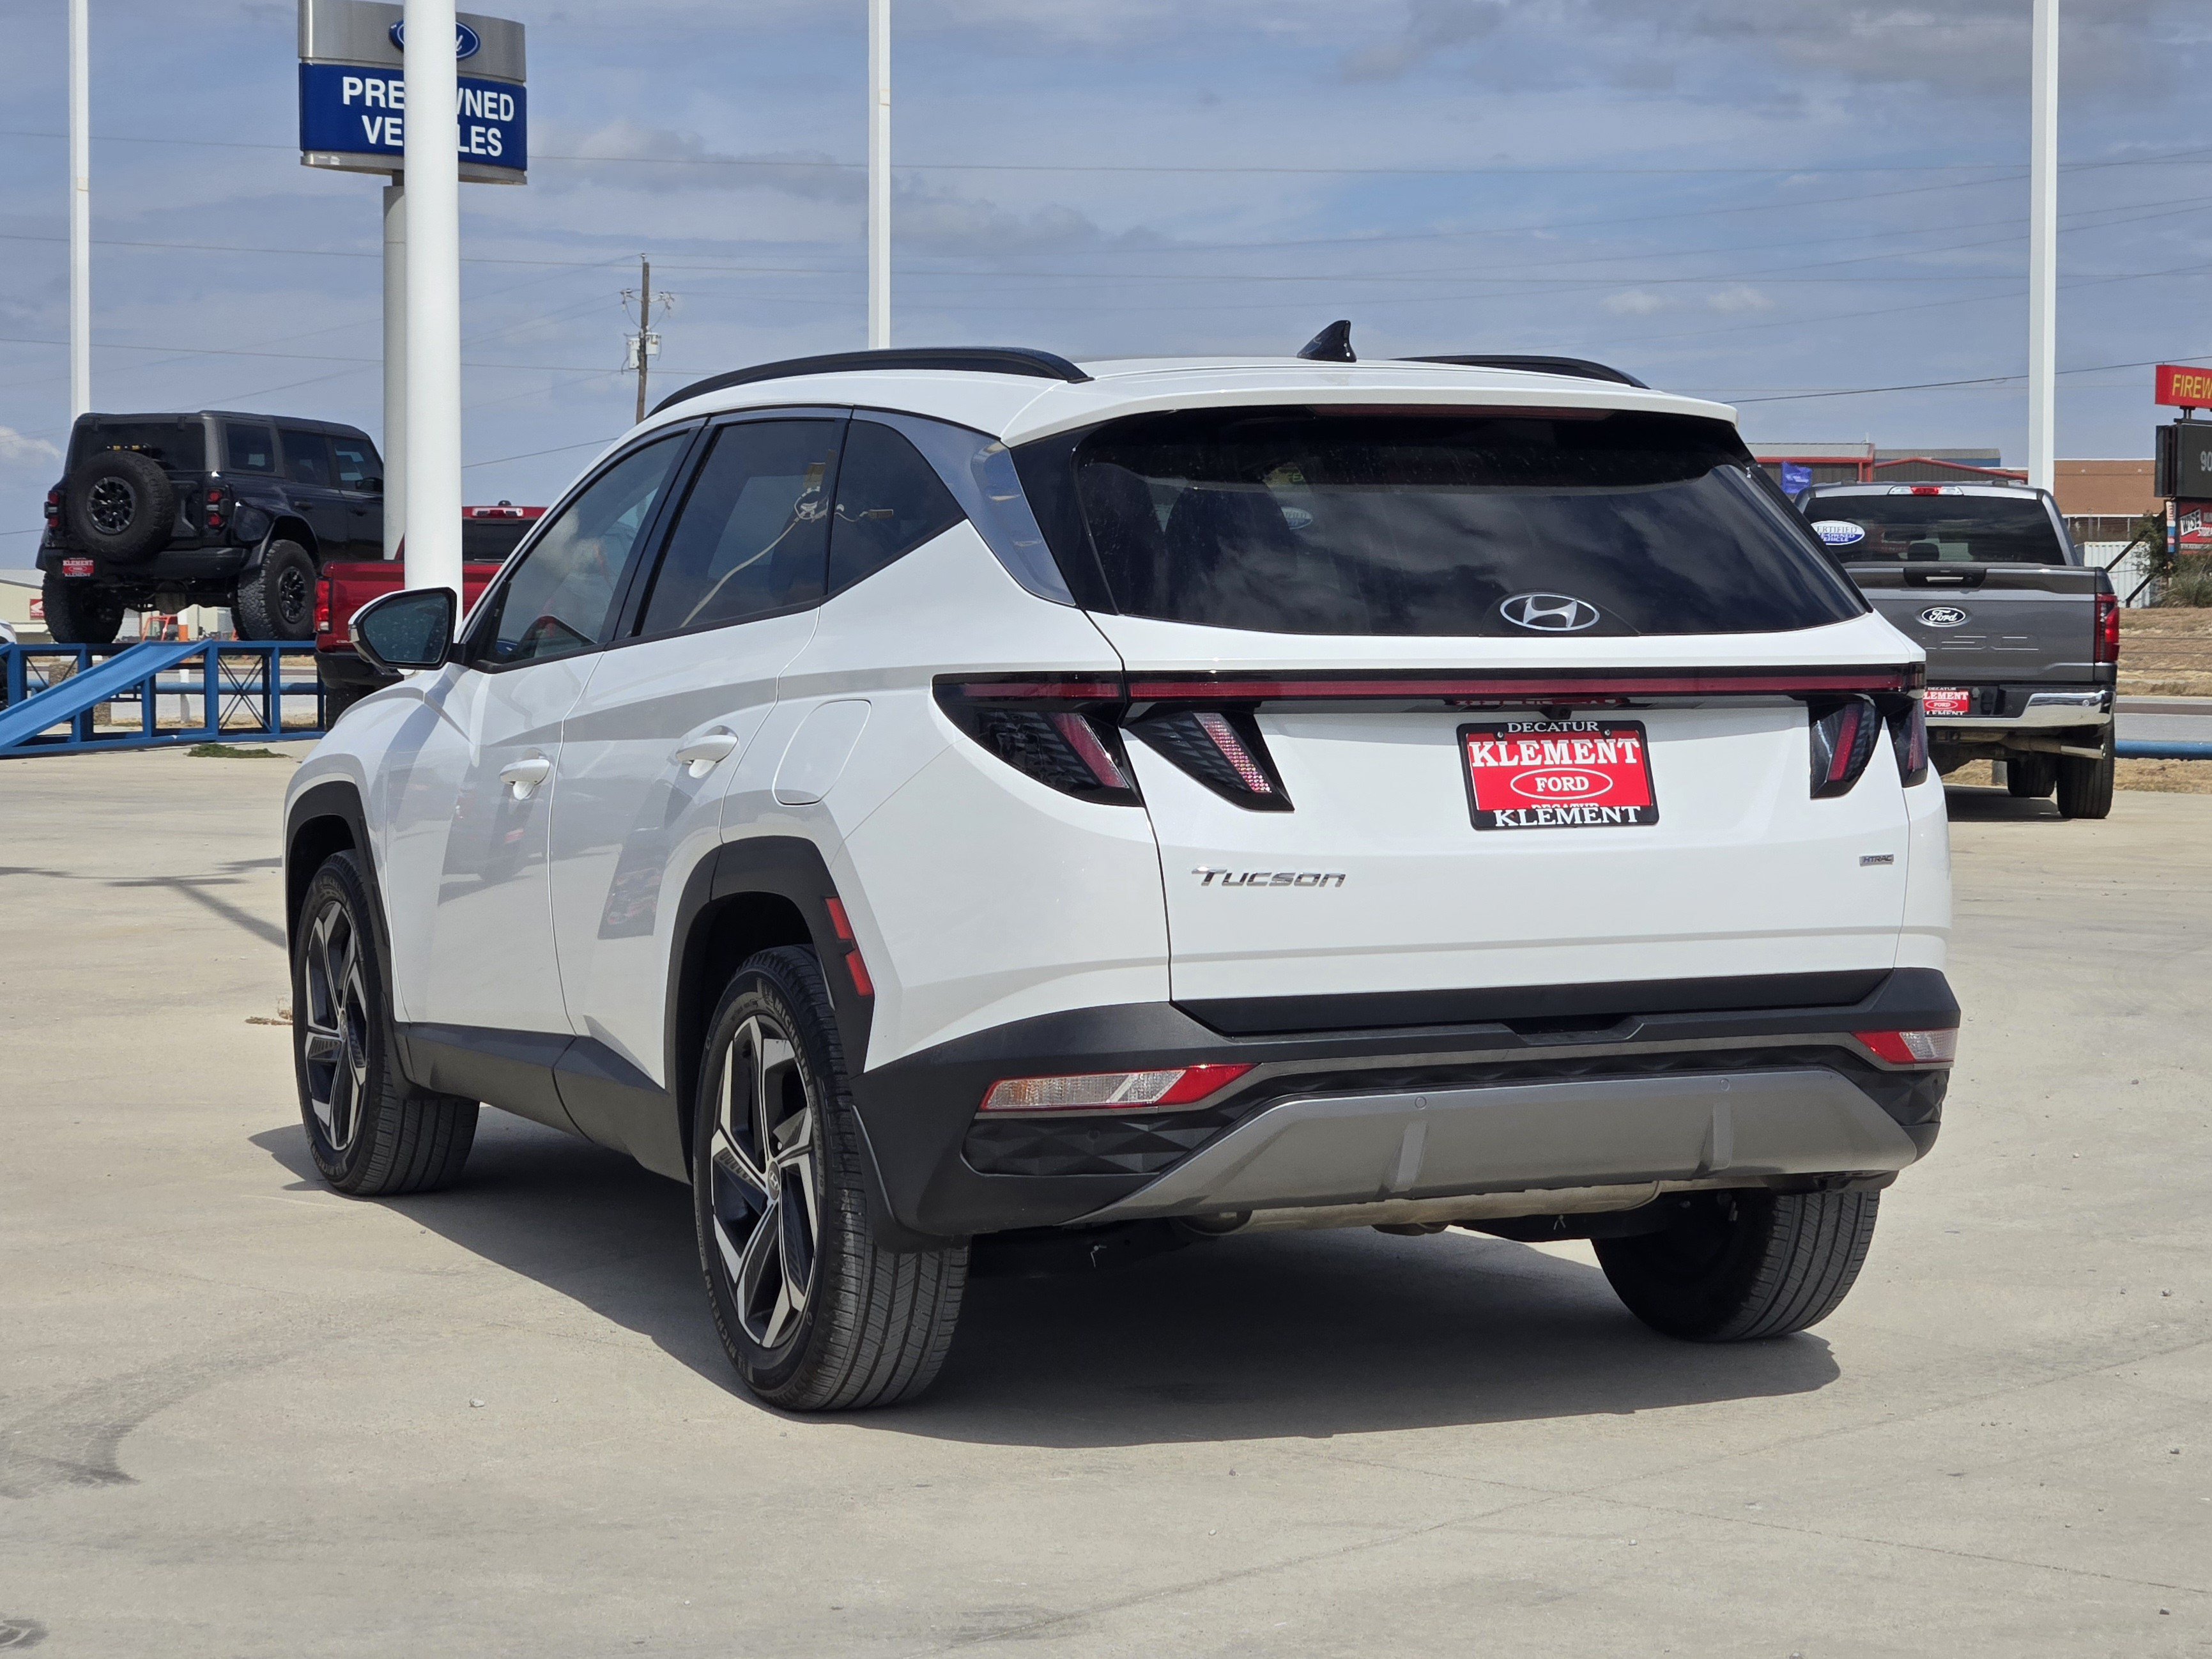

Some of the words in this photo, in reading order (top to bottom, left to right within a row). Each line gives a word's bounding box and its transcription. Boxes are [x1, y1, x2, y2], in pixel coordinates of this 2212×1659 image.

[1929, 609, 1957, 621] Ford
[1923, 691, 1969, 700] LEMENT
[1507, 721, 1599, 733] DECATUR
[1469, 737, 1640, 768] KLEMENT
[1534, 776, 1590, 792] FORD
[1493, 806, 1641, 827] KLEMENT
